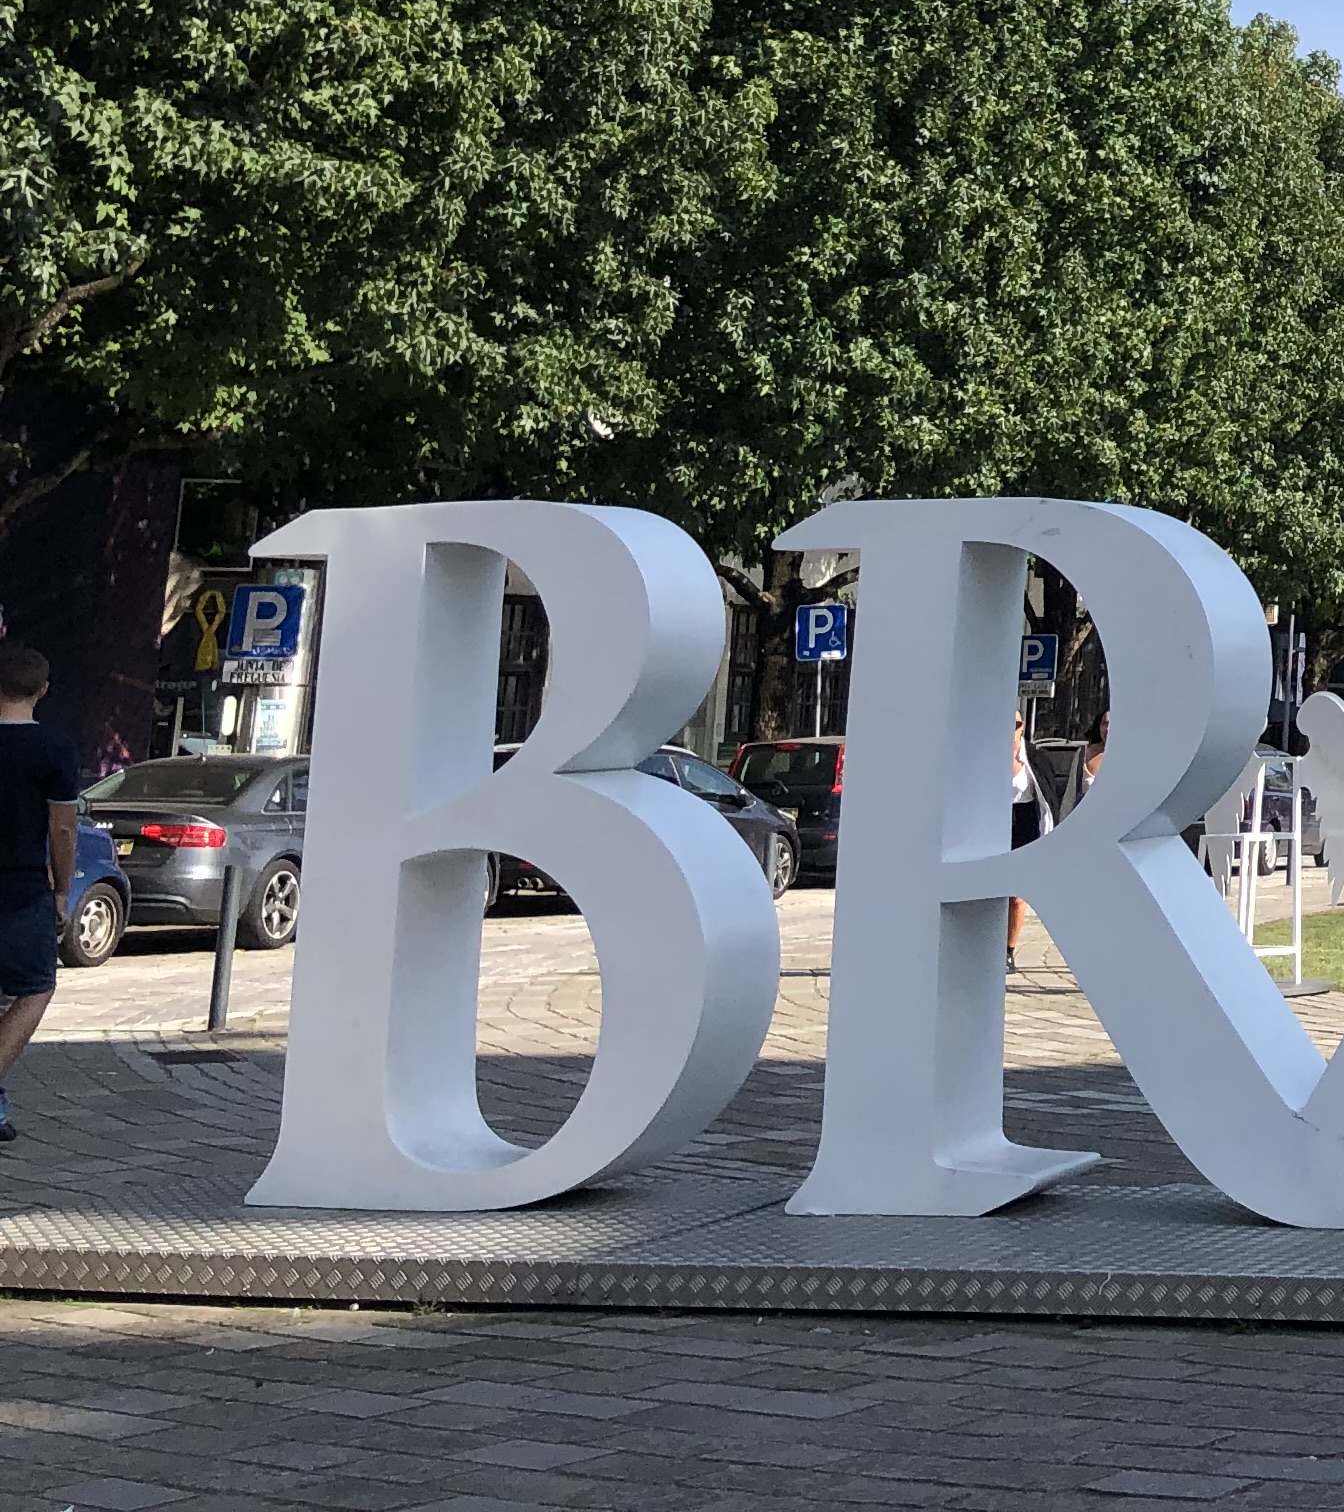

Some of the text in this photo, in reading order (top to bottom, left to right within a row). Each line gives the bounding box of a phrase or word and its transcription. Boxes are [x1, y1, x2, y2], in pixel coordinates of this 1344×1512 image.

[242, 591, 287, 651] P
[809, 609, 834, 648] P
[234, 660, 285, 672] JUNTA DE
[1022, 639, 1044, 673] P
[230, 672, 287, 683] FREGUESIA
